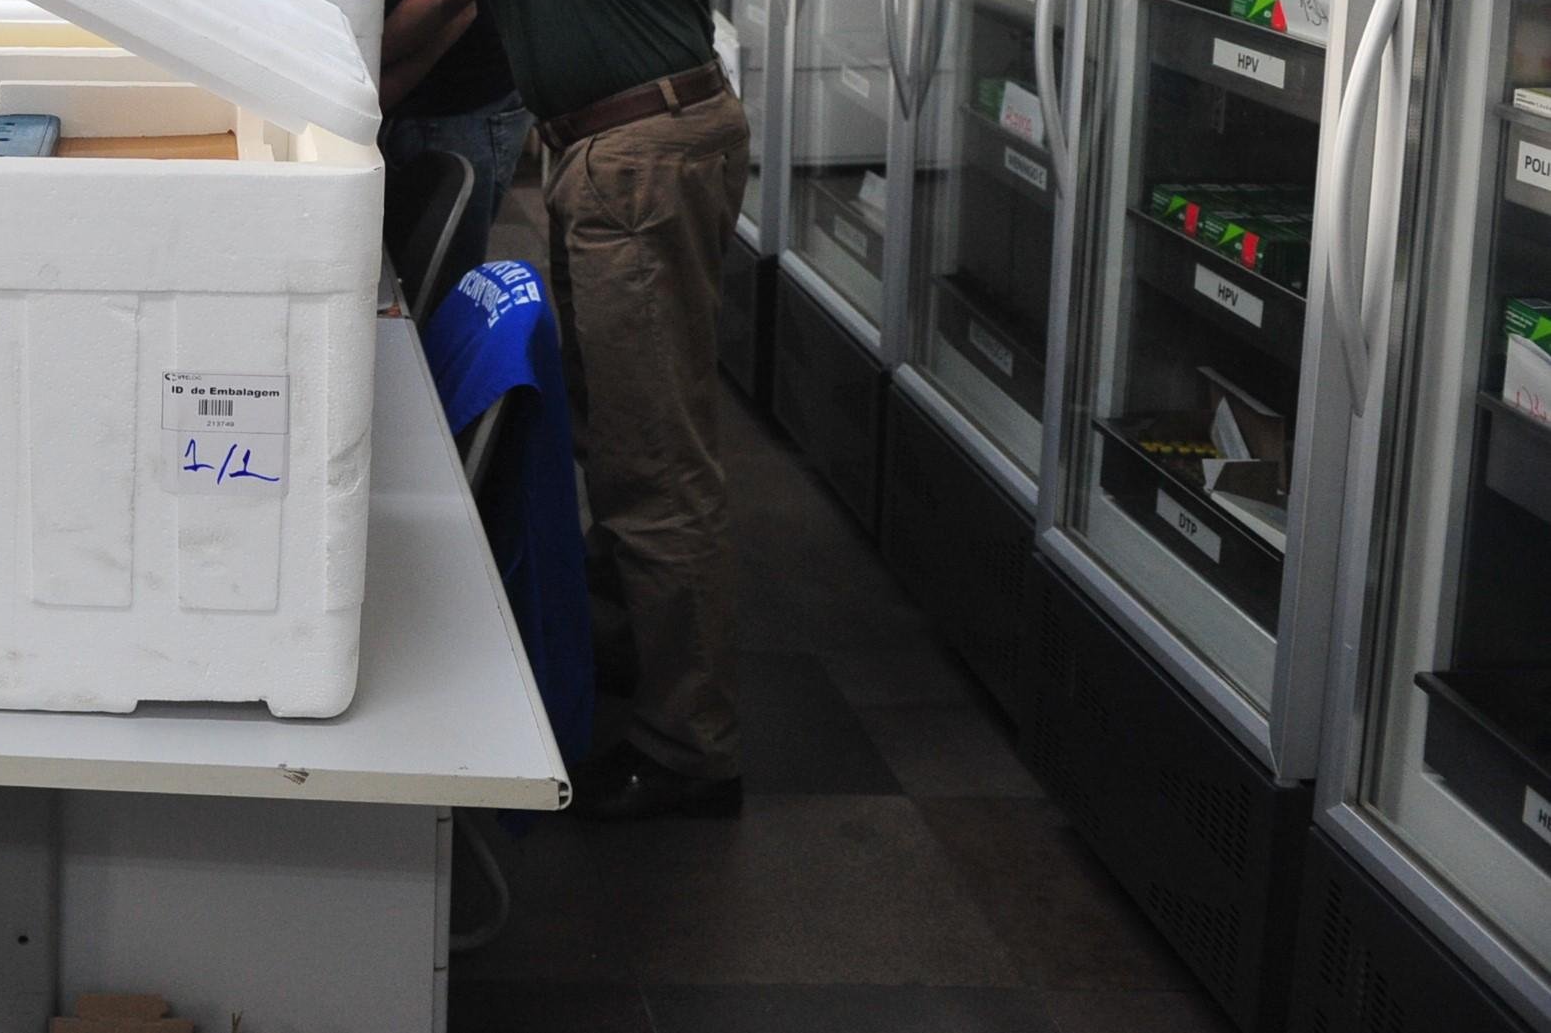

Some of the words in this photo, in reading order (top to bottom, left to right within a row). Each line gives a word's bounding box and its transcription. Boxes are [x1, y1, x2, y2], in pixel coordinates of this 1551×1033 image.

[1237, 52, 1259, 73] HPV
[1218, 282, 1239, 307] HPV
[171, 386, 184, 394] ID
[190, 387, 206, 395] de
[209, 387, 280, 398] Embalagem
[1178, 512, 1198, 536] DTP
